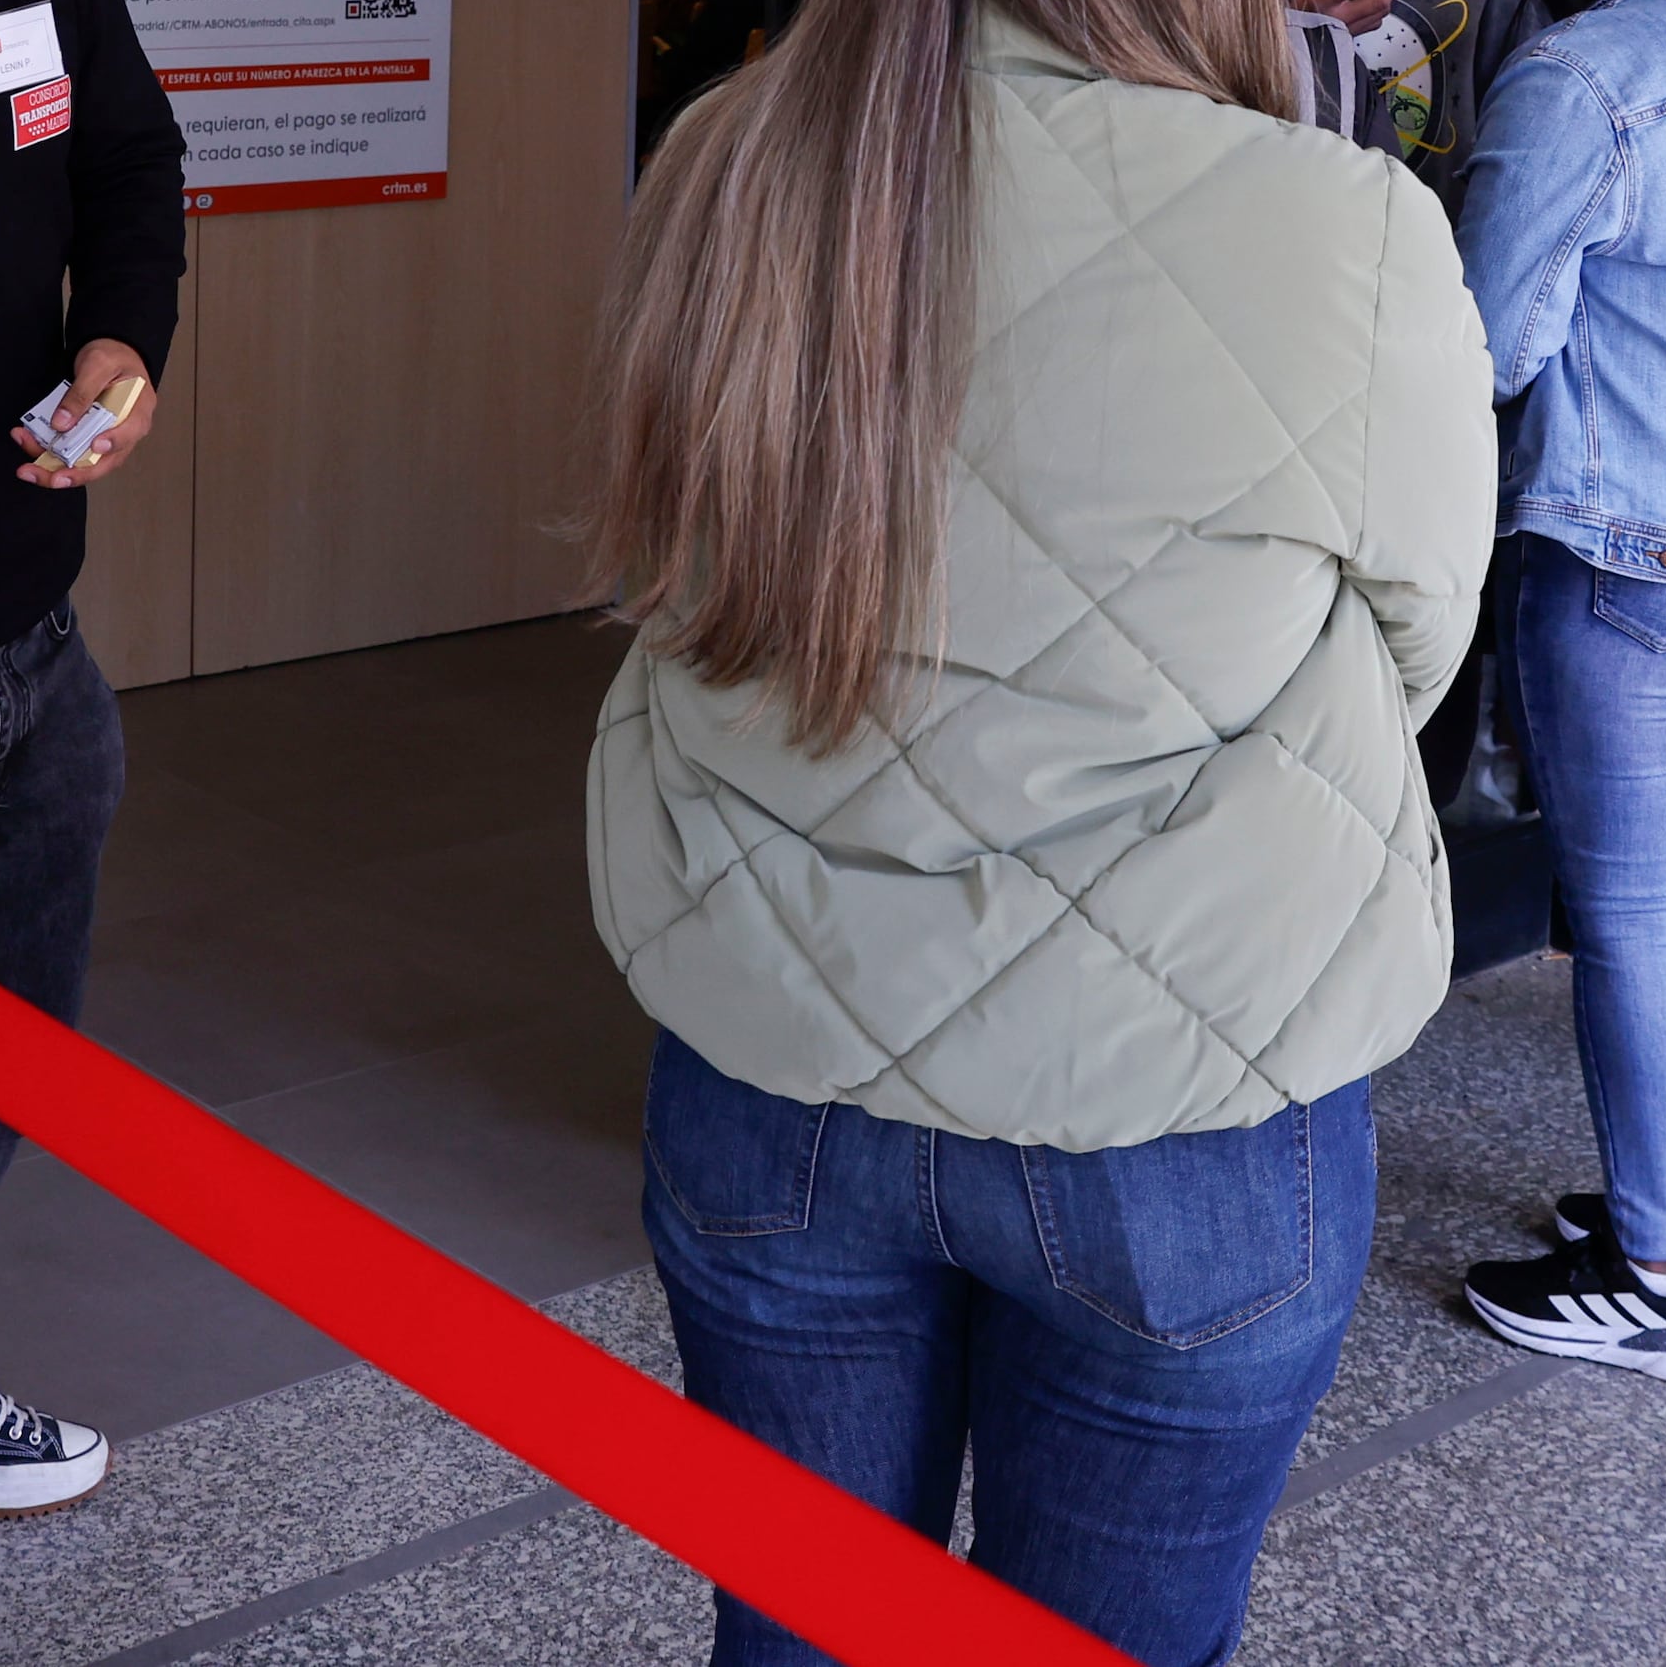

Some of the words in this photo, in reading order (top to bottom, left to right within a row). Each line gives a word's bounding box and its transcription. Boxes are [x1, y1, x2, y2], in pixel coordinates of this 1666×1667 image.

[0, 60, 24, 74] LENIN
[159, 75, 166, 85] Y
[168, 73, 201, 85] ESPERE
[203, 73, 211, 83] A
[213, 72, 233, 83] QUE
[236, 71, 248, 82] SU
[250, 68, 291, 81] NÚMERO
[293, 67, 343, 79] APAREZCA
[345, 66, 357, 77] EN
[359, 66, 370, 76] LA
[372, 65, 415, 76] PANTALLA
[29, 81, 69, 106] CONSORCIO
[186, 115, 270, 136] requieran,
[274, 113, 288, 129] el
[294, 113, 336, 131] pago
[340, 112, 356, 125] se
[361, 105, 427, 124] realizará
[198, 144, 241, 161] cada
[246, 144, 284, 159] caso
[289, 143, 305, 156] se
[310, 138, 369, 156] indique
[382, 181, 428, 196] crtm.es
